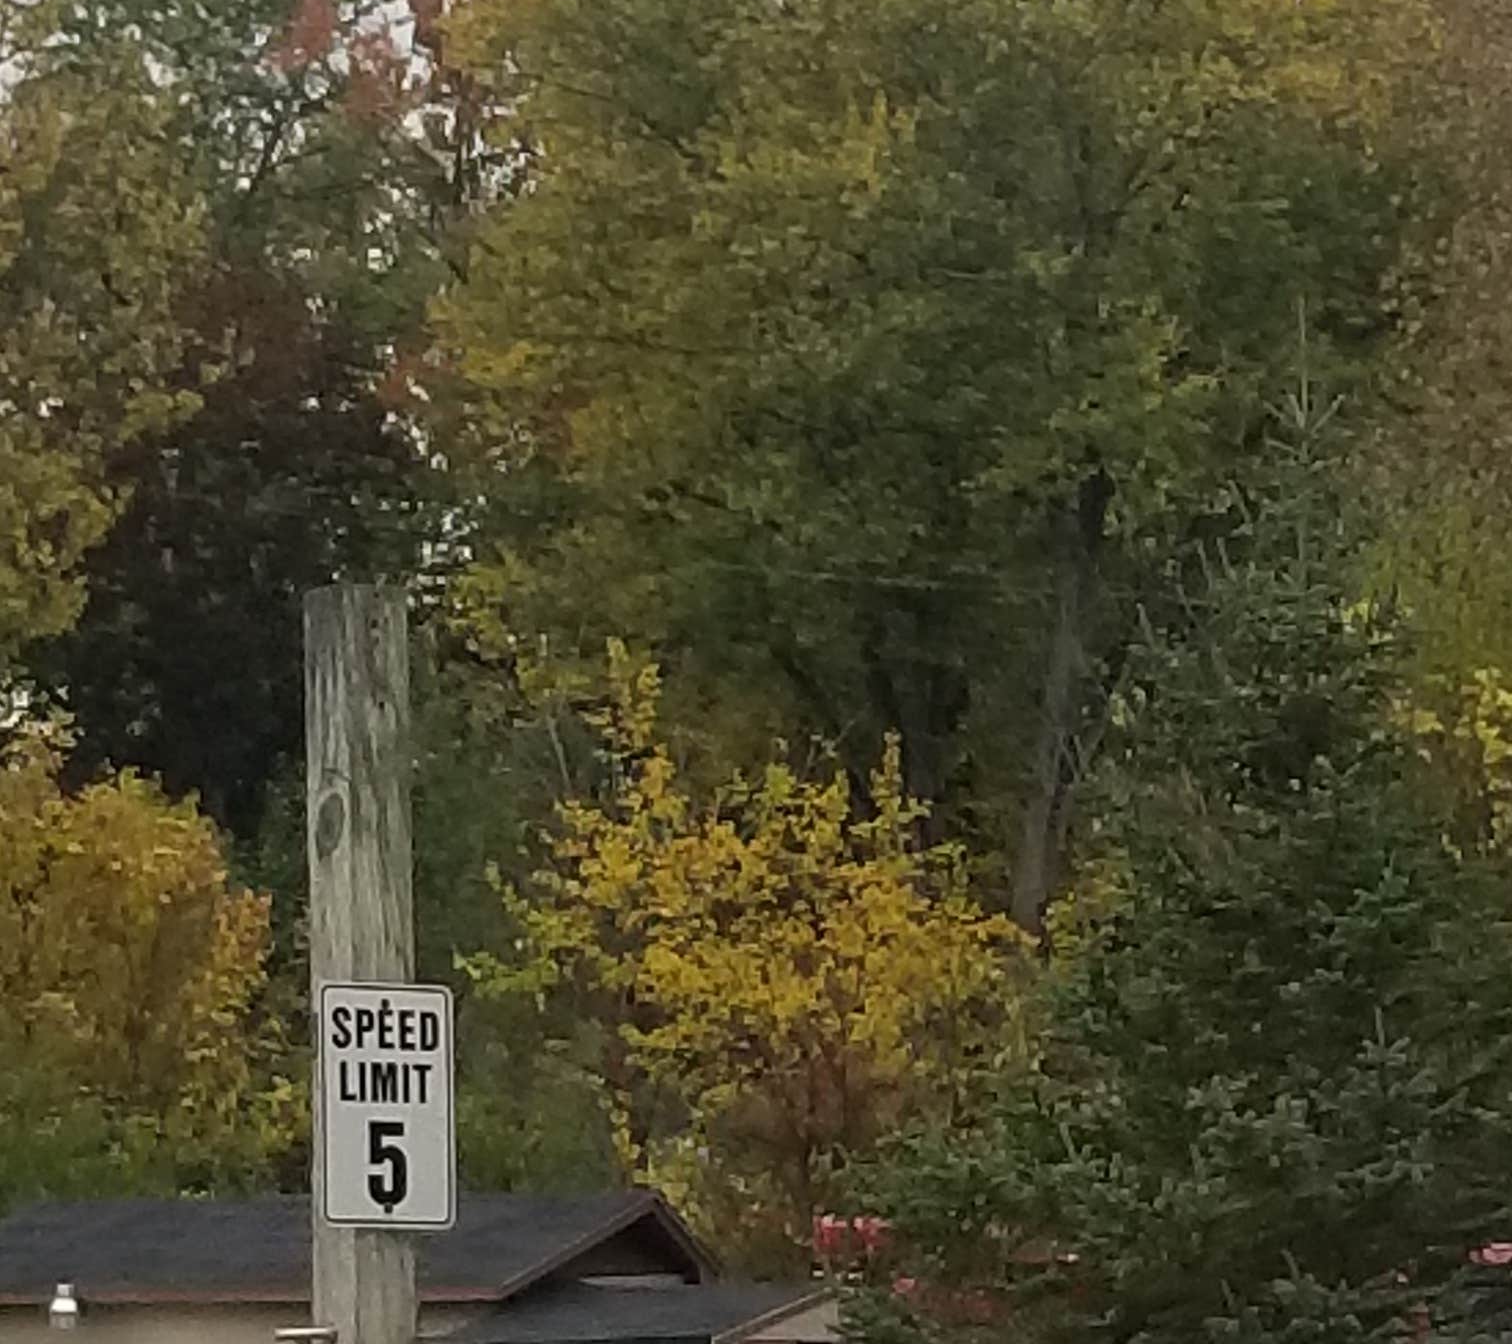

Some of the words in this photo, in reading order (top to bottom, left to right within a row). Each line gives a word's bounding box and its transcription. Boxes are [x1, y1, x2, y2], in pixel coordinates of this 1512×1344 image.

[331, 1006, 440, 1052] SPEED
[339, 1061, 433, 1104] LIMIT
[367, 1120, 408, 1207] 5
